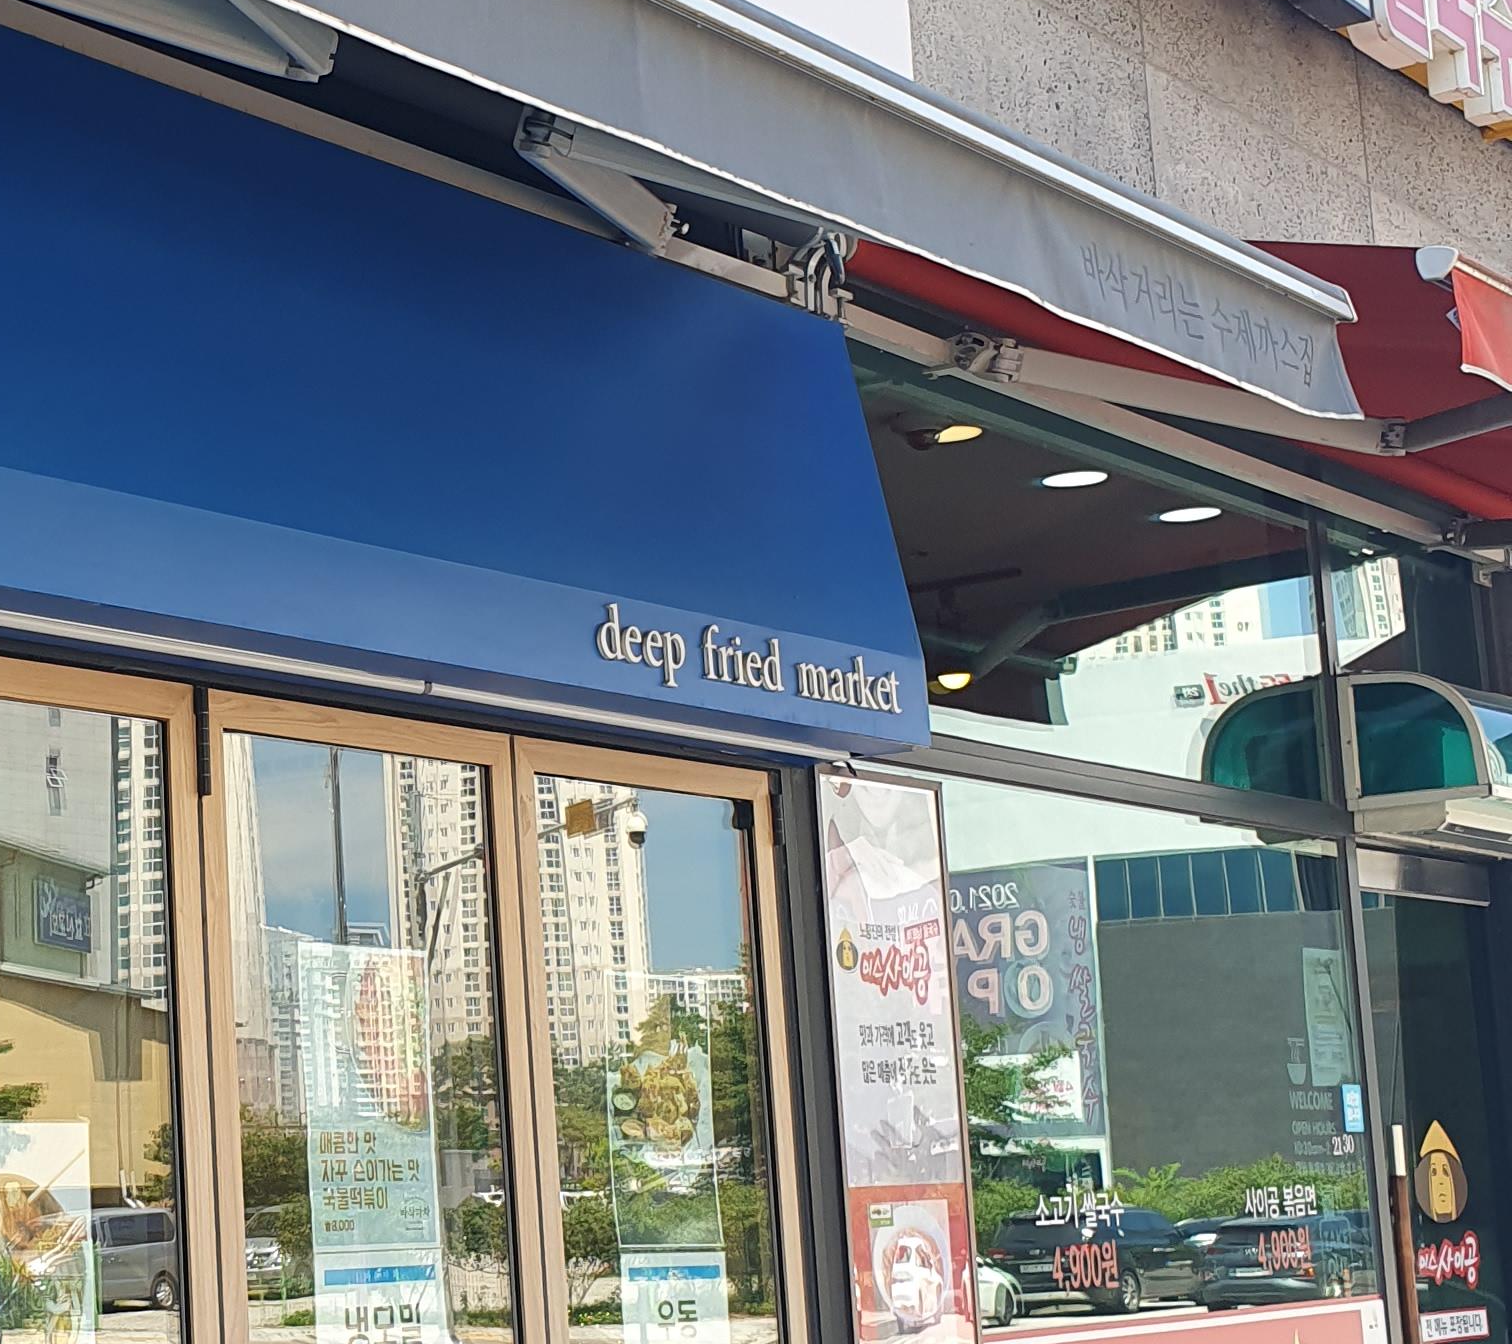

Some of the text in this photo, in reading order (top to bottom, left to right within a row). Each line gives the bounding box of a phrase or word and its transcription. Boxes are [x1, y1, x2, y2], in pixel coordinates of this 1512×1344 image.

[1081, 242, 1314, 388] 바삭거리는 수제까스집
[597, 603, 904, 714] deep fried market
[1289, 1090, 1334, 1111] WELCOME
[319, 1131, 377, 1155] 매콤한 맛
[320, 1159, 348, 1183] 자꾸
[407, 1158, 421, 1182] 맛
[1035, 1190, 1125, 1231] 소고기 쌀국수
[1245, 1183, 1318, 1220] 사이공 볶음면
[1053, 1238, 1120, 1292] 4,900원
